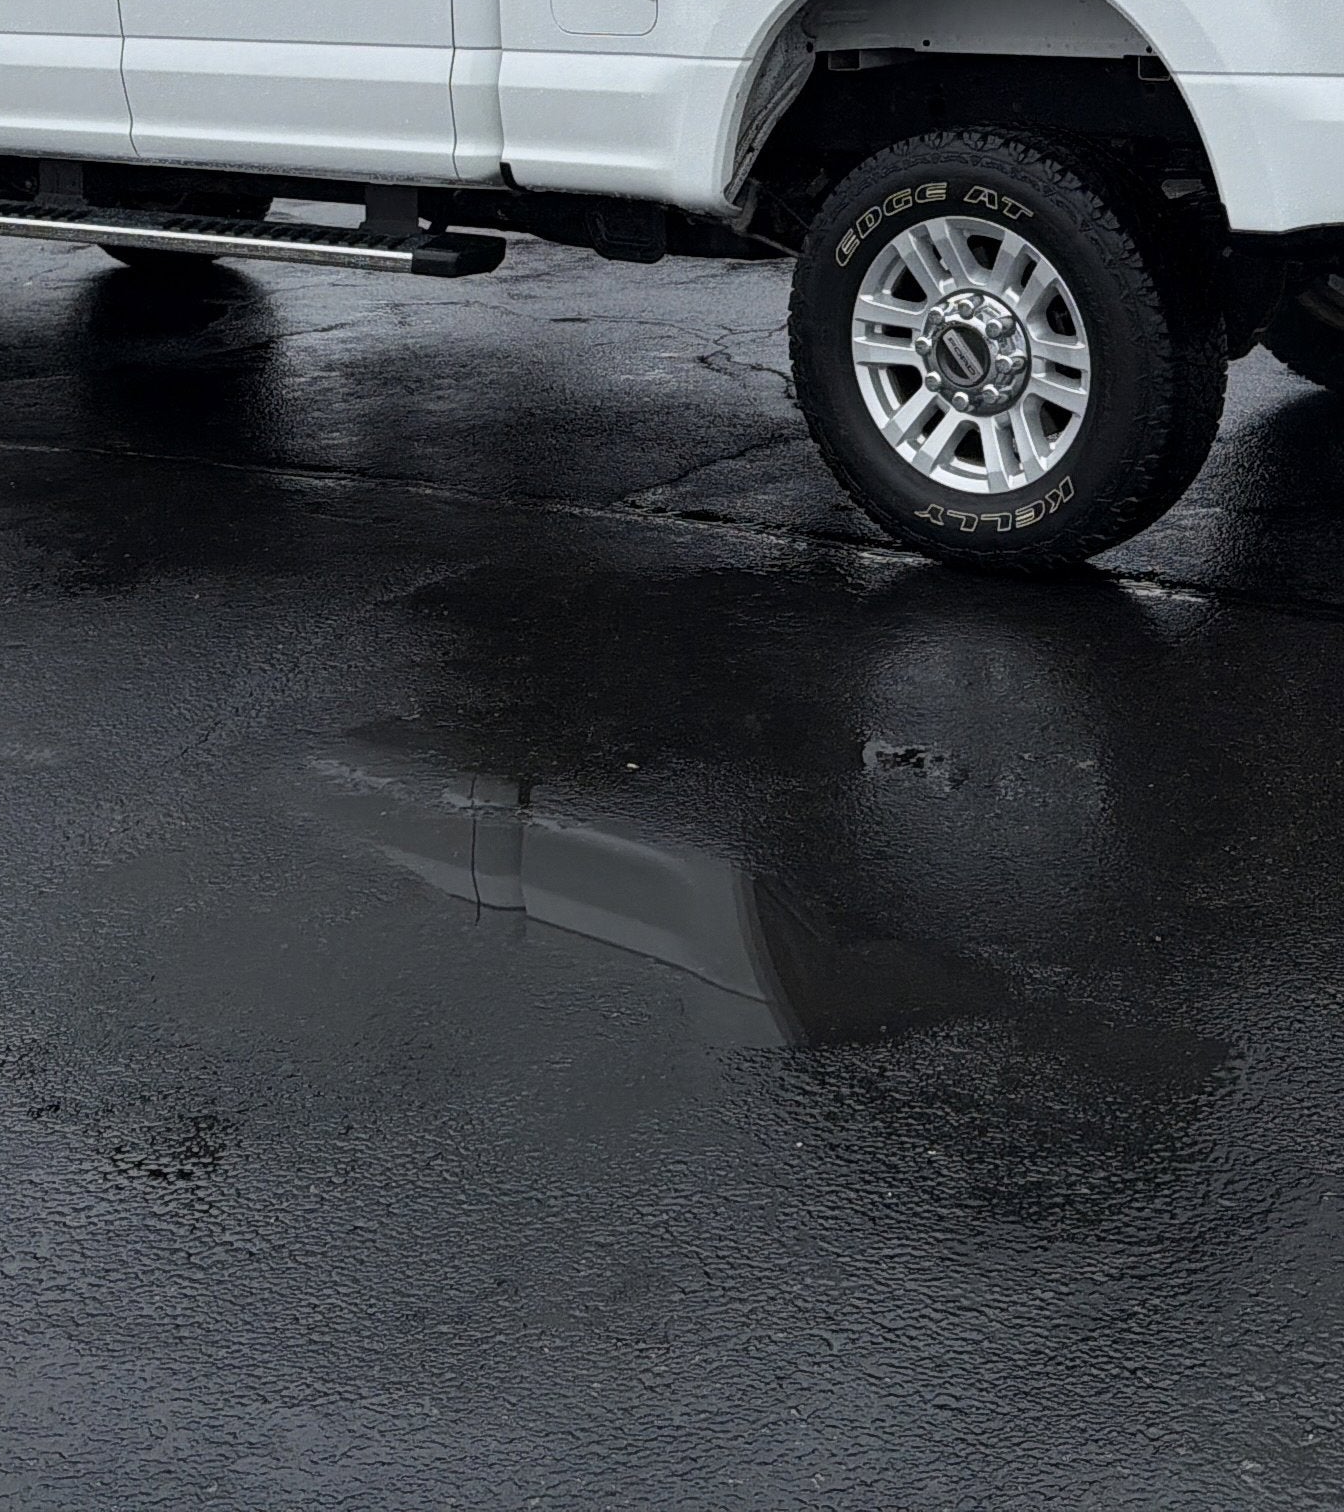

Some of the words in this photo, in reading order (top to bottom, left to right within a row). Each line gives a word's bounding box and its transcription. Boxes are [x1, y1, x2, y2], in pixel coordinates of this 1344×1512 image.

[835, 182, 948, 267] EDGE
[964, 185, 1035, 221] AT
[948, 337, 976, 376] FORD
[914, 475, 1076, 533] KELLY
